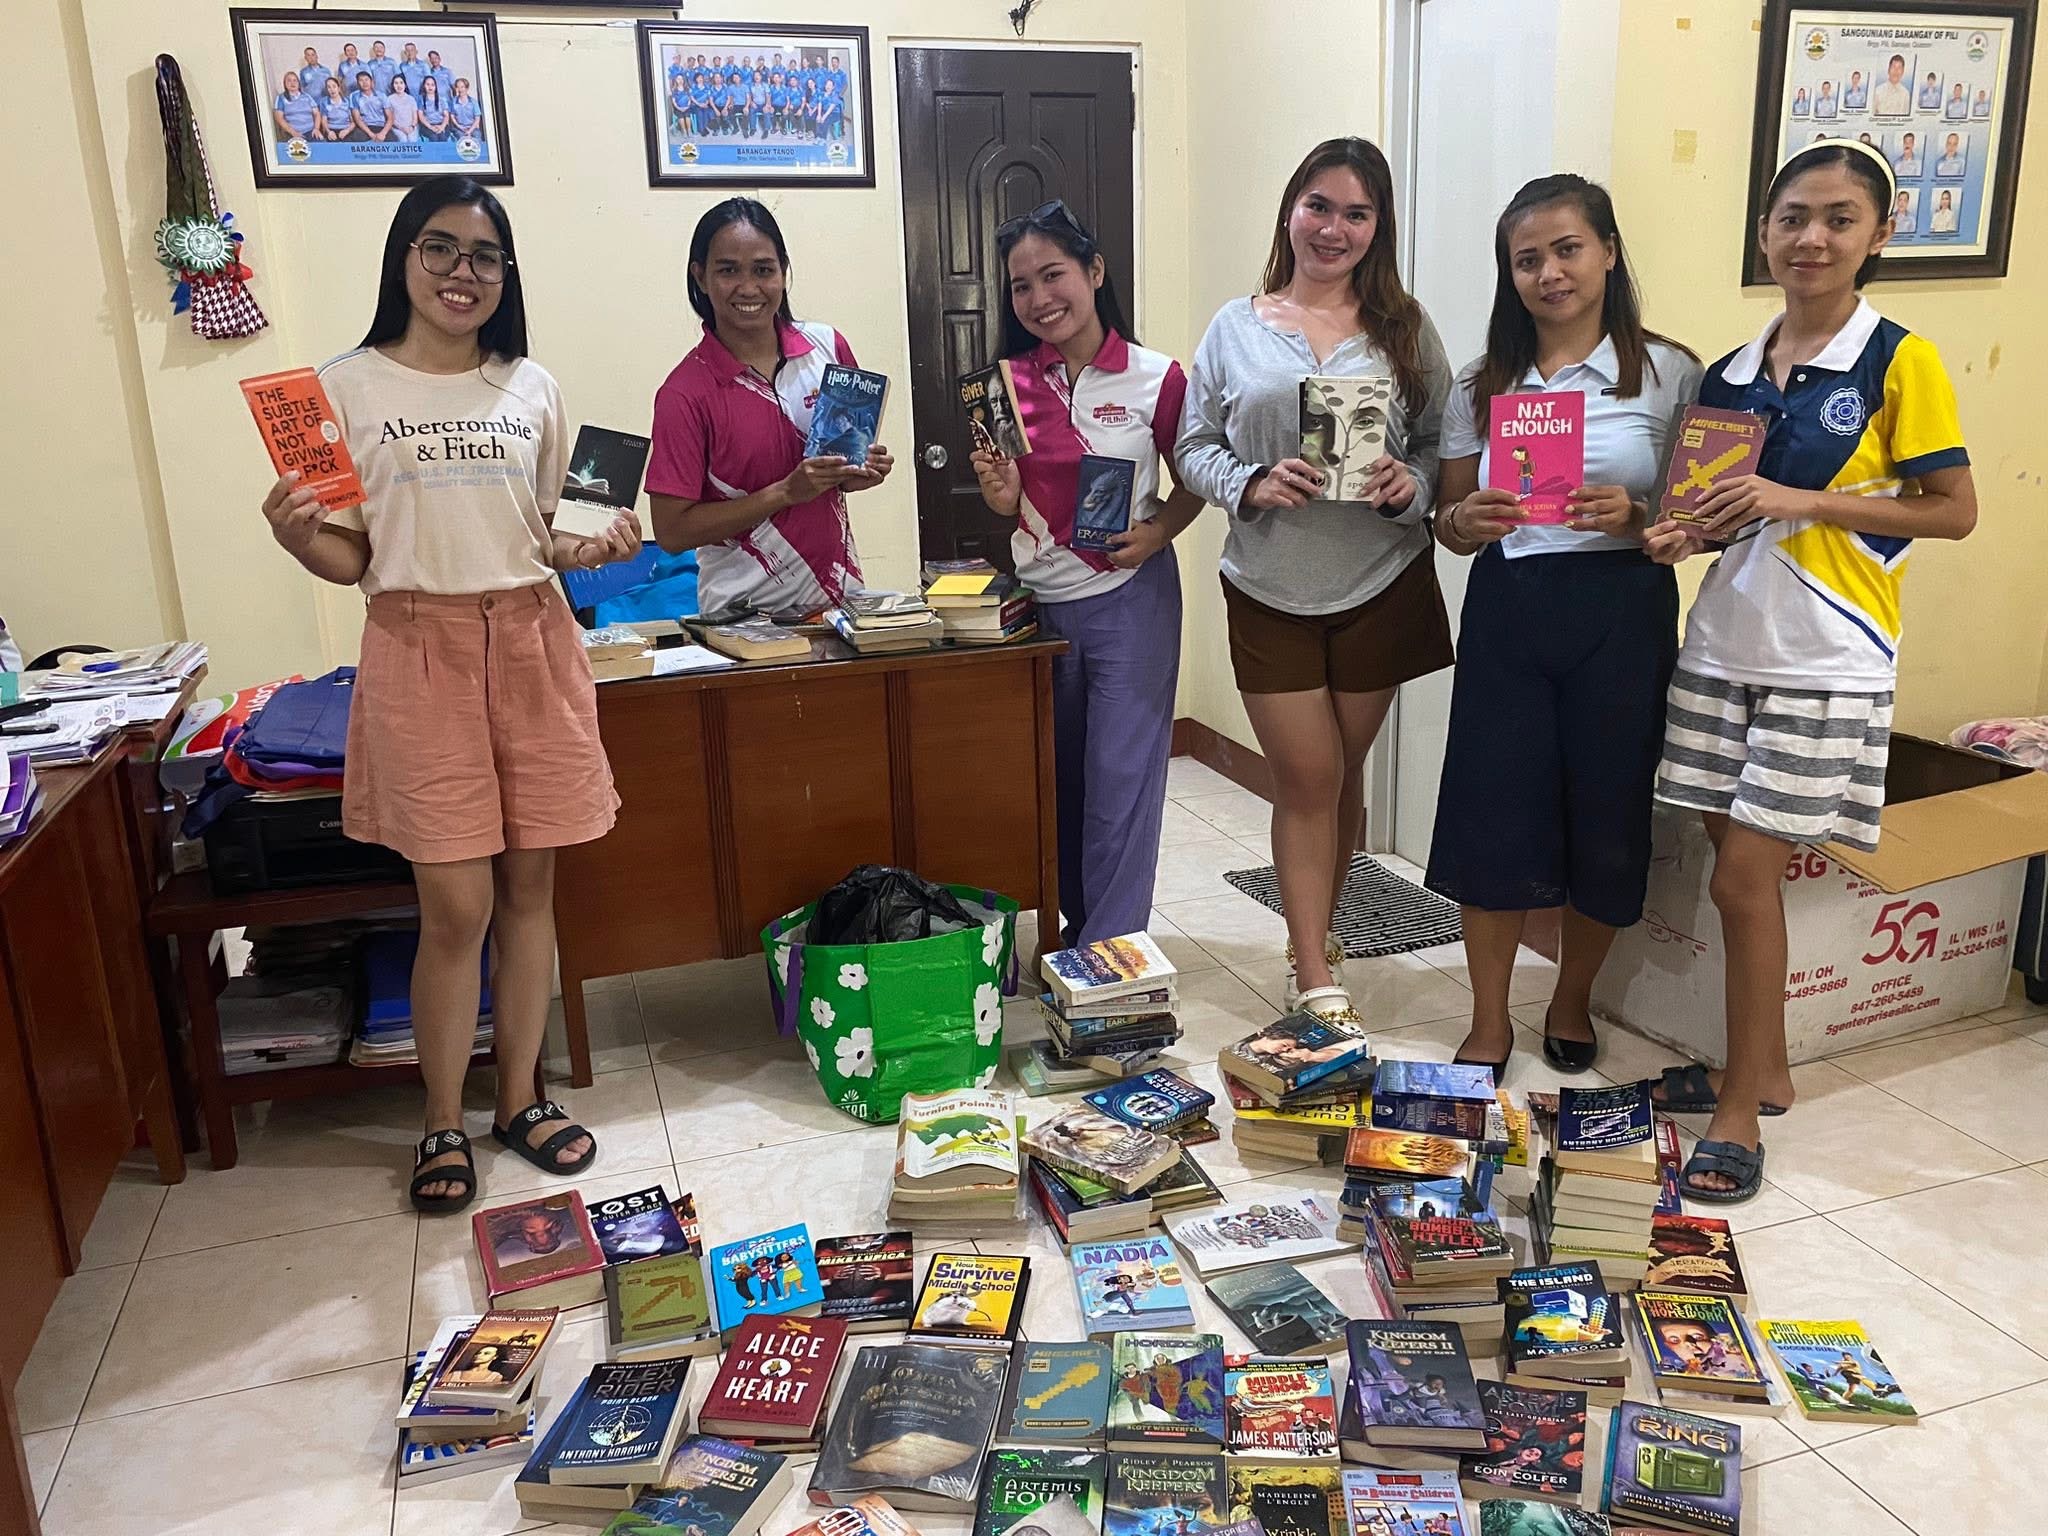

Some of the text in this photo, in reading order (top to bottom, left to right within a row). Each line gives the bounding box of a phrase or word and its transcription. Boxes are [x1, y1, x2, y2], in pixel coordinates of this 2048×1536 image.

[1841, 29, 1893, 39] SANGGUNIANG
[1895, 30, 1934, 40] BARANGAY
[1935, 31, 1944, 40] OF
[351, 145, 423, 153] BARANGAY JUSTICE
[828, 370, 852, 387] Harry
[852, 374, 881, 395] Potter
[255, 387, 288, 406] THE
[961, 381, 986, 403] GIVER
[262, 397, 320, 421] SUBTLE
[1517, 401, 1556, 419] NAT
[271, 412, 323, 436] ART OF
[380, 416, 532, 445] Abercrombie
[1501, 417, 1572, 438] ENOUGH
[1689, 417, 1757, 436] MINECRAFT
[275, 432, 307, 452] NOT
[417, 436, 506, 461] & Fitch
[282, 443, 334, 467] GIVING
[1785, 852, 1827, 881] 5G
[1862, 899, 1940, 965] 5G
[1949, 933, 1959, 945] IL
[1968, 925, 1988, 940] WIS
[1995, 919, 2006, 933] IA
[1789, 970, 1805, 985] MI
[1815, 965, 1834, 979] OH
[1871, 974, 1912, 994] OFFICE
[1850, 986, 1924, 1014] 847-260-5459
[1106, 1018, 1127, 1028] EARL
[1825, 997, 1941, 1036] 5genterprisesllc.com
[1145, 1078, 1190, 1104] HIDDEN
[1152, 1073, 1200, 1102] FIGURES
[912, 1099, 997, 1117] Turning Points
[1605, 1130, 1650, 1144] HOROWITZ
[602, 1201, 664, 1222] OUTER SPACE
[1409, 1221, 1464, 1235] BOMBS
[1413, 1232, 1485, 1247] HITLER
[721, 1235, 806, 1266] BABYSITTERS
[817, 1256, 854, 1266] MIKE
[855, 1252, 906, 1262] LUPICA
[1083, 1244, 1169, 1264] NADIA
[935, 1263, 1016, 1281] Survive
[1509, 1279, 1538, 1287] THE
[1539, 1273, 1594, 1286] ISLAND
[1511, 1266, 1590, 1279] MINECRAFT
[928, 1279, 1016, 1292] Middle School
[1638, 1300, 1680, 1311] ALIENS
[1651, 1307, 1725, 1323] HOMEWORK
[1369, 1330, 1447, 1341] KINGDOM
[1770, 1322, 1801, 1333] MATT
[745, 1332, 825, 1358] ALICE
[1125, 1338, 1212, 1349] HORIZON
[1366, 1338, 1455, 1351] KEEPERS II
[1768, 1329, 1864, 1347] CHRISTOPHER
[1527, 1342, 1616, 1356] MAX BROOKS
[605, 1365, 679, 1383] ALEX
[737, 1360, 754, 1371] BY
[593, 1378, 676, 1398] RIDER
[1245, 1373, 1308, 1387] MIDDLE
[1247, 1382, 1312, 1395] SCHOOL
[630, 1395, 659, 1403] BLANK
[724, 1377, 809, 1404] HEART
[1484, 1386, 1577, 1408] ARTEMIS
[1506, 1410, 1524, 1418] LAST
[1527, 1414, 1566, 1423] GUARDIAN
[1127, 1424, 1204, 1433] SCOTT WESTERFELD
[1638, 1418, 1728, 1454] RING
[1228, 1430, 1336, 1447] JAMES PATTERSON
[559, 1448, 606, 1460] ANTHONY
[607, 1441, 658, 1456] HOROWITZ
[1122, 1458, 1214, 1467] RIDLEY PEARSON
[740, 1475, 758, 1488] III
[1116, 1464, 1217, 1481] KINGDOM
[1474, 1465, 1507, 1477] EOIN
[1513, 1471, 1568, 1484] COLFER
[1005, 1478, 1082, 1492] ARTEMIS
[1127, 1479, 1206, 1493] KEEPERS
[1350, 1488, 1368, 1496] The
[1409, 1490, 1456, 1499] Children
[1623, 1490, 1662, 1505] BEHIND
[1665, 1500, 1701, 1513] ENEMY
[1703, 1510, 1735, 1522] LINES
[1626, 1498, 1670, 1512] JENNIFER
[1688, 1512, 1730, 1527] NIELSEN
[1283, 1516, 1296, 1524] A
